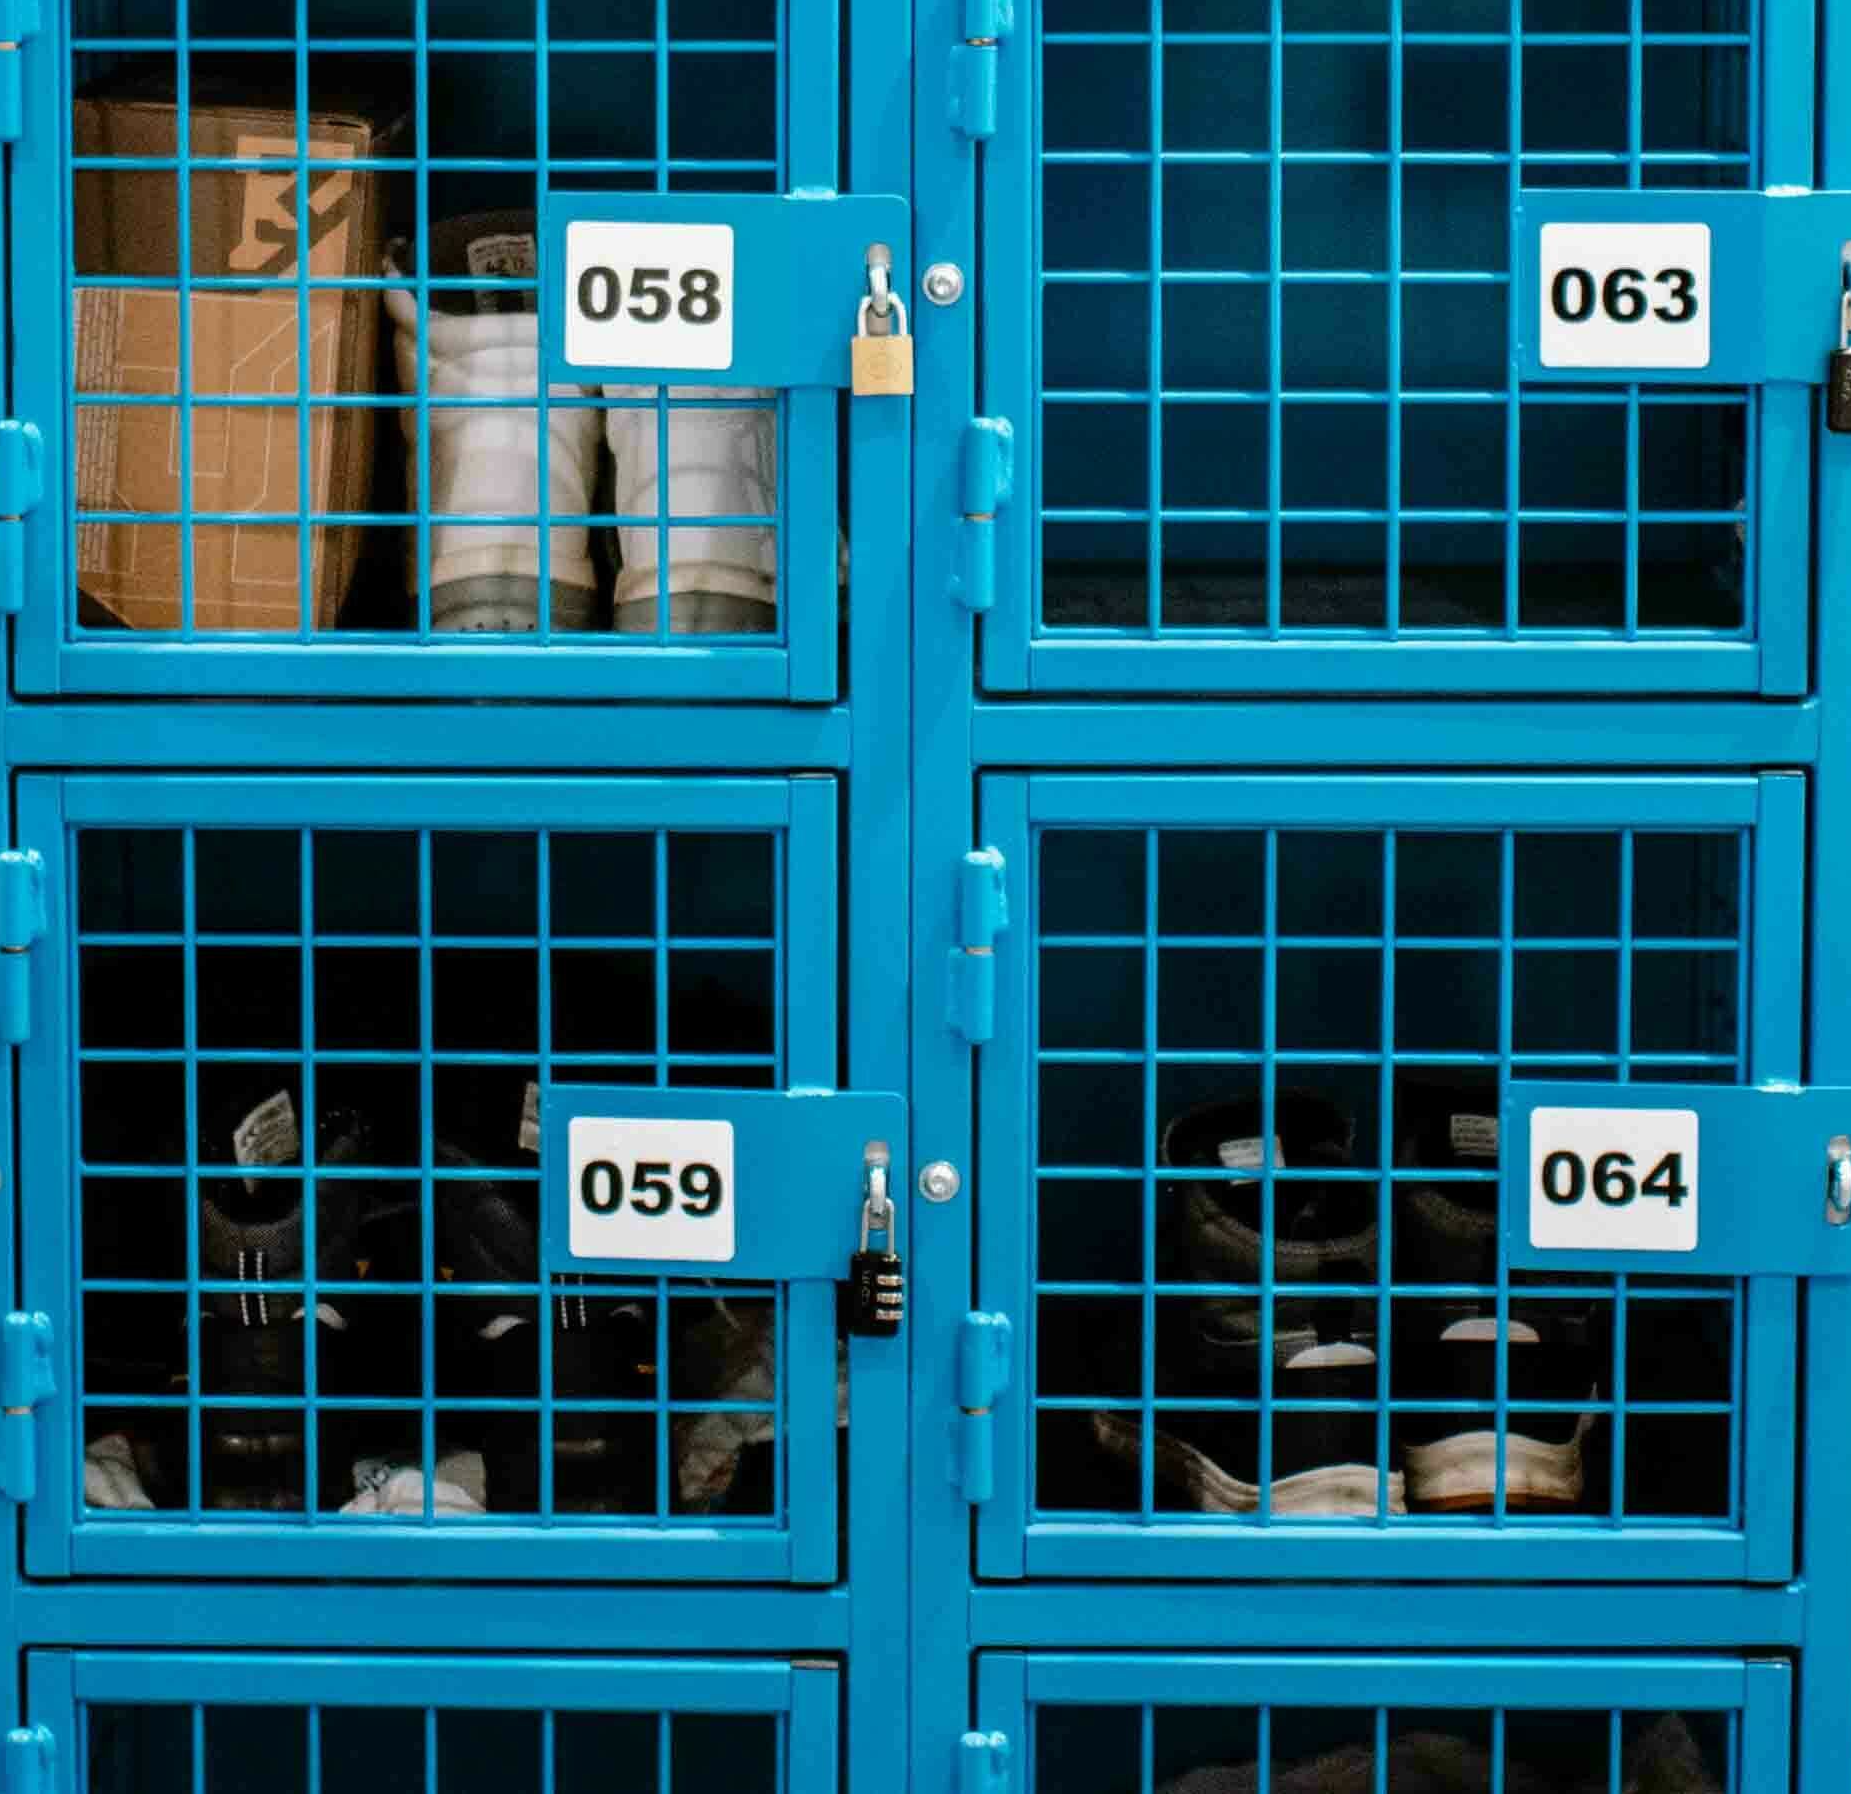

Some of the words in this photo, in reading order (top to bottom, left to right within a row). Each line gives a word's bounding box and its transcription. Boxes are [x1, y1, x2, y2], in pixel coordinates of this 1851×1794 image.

[577, 265, 721, 324] 058
[1550, 266, 1698, 324] 063
[580, 1159, 723, 1218] 059
[1540, 1149, 1689, 1208] 064
